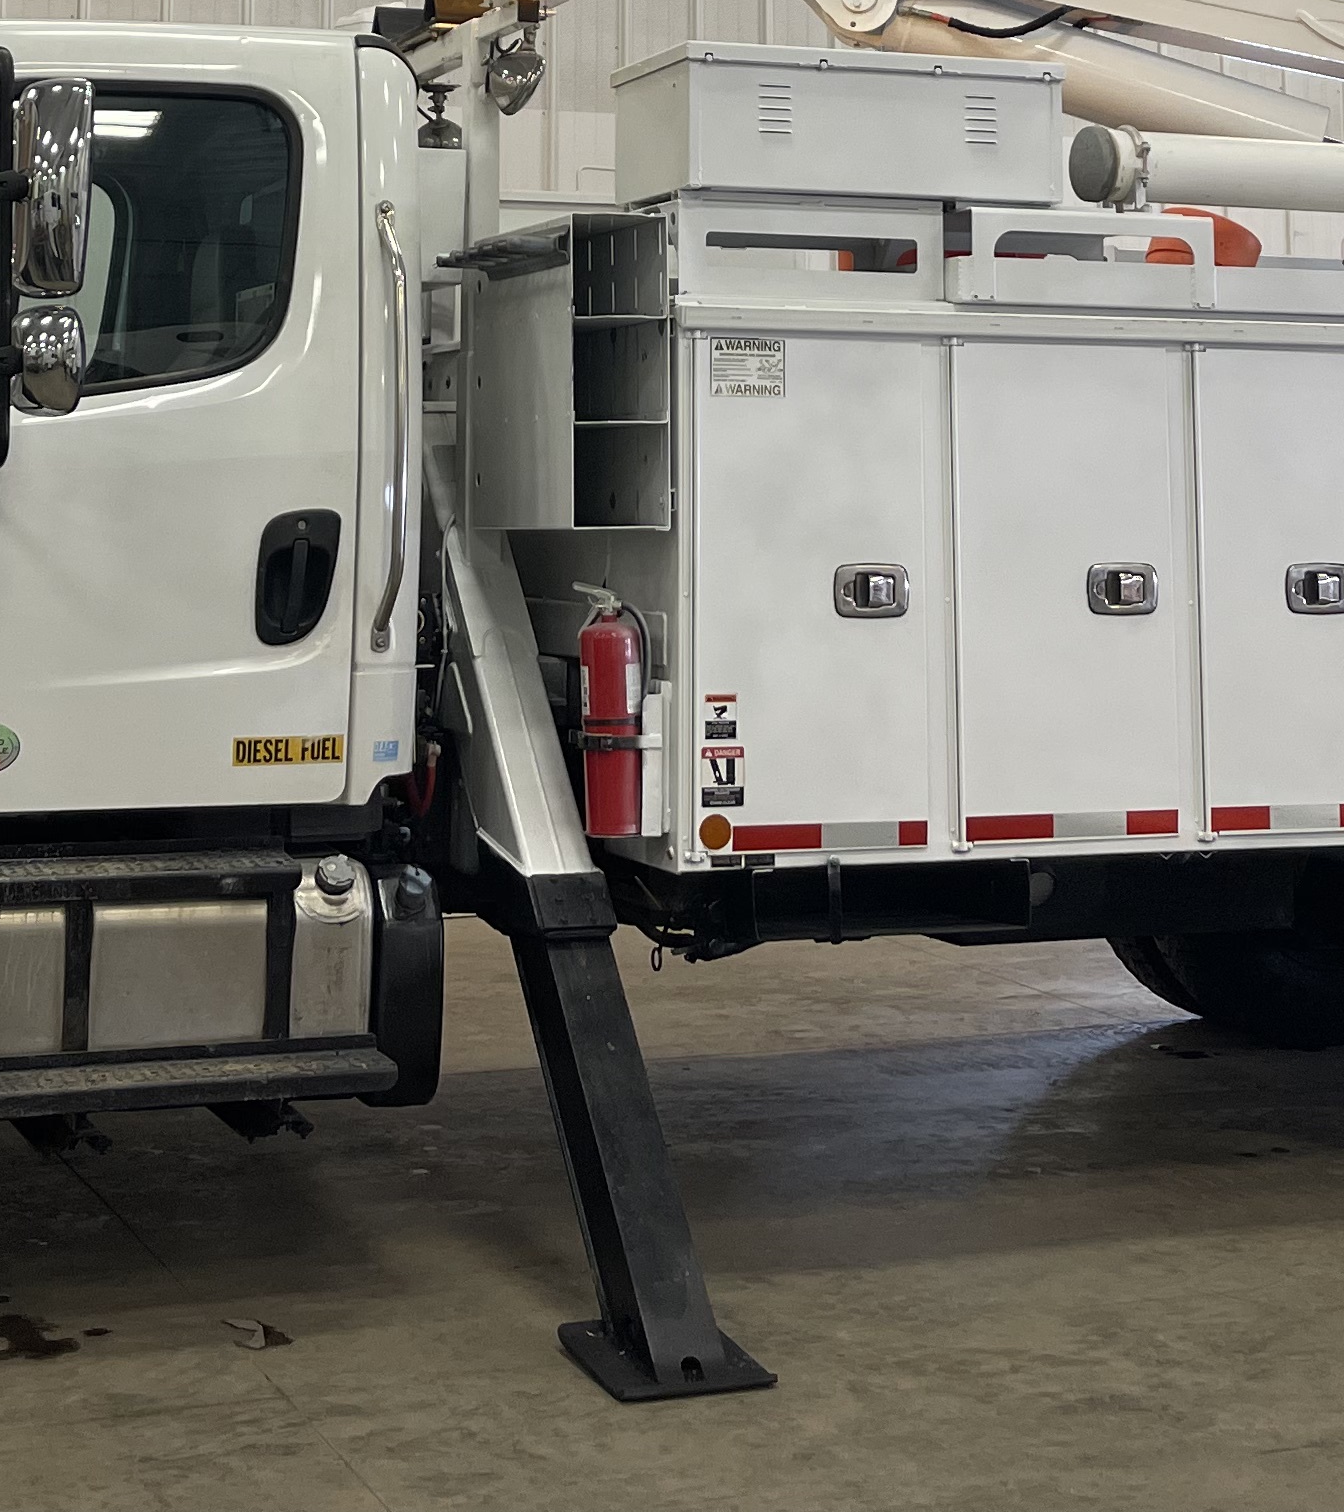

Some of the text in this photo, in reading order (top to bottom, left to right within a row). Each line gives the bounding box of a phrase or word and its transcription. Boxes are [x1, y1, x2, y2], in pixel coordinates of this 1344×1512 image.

[725, 340, 781, 352] WARNING
[725, 384, 781, 396] WARNING
[236, 737, 340, 763] DIESEL FUEL
